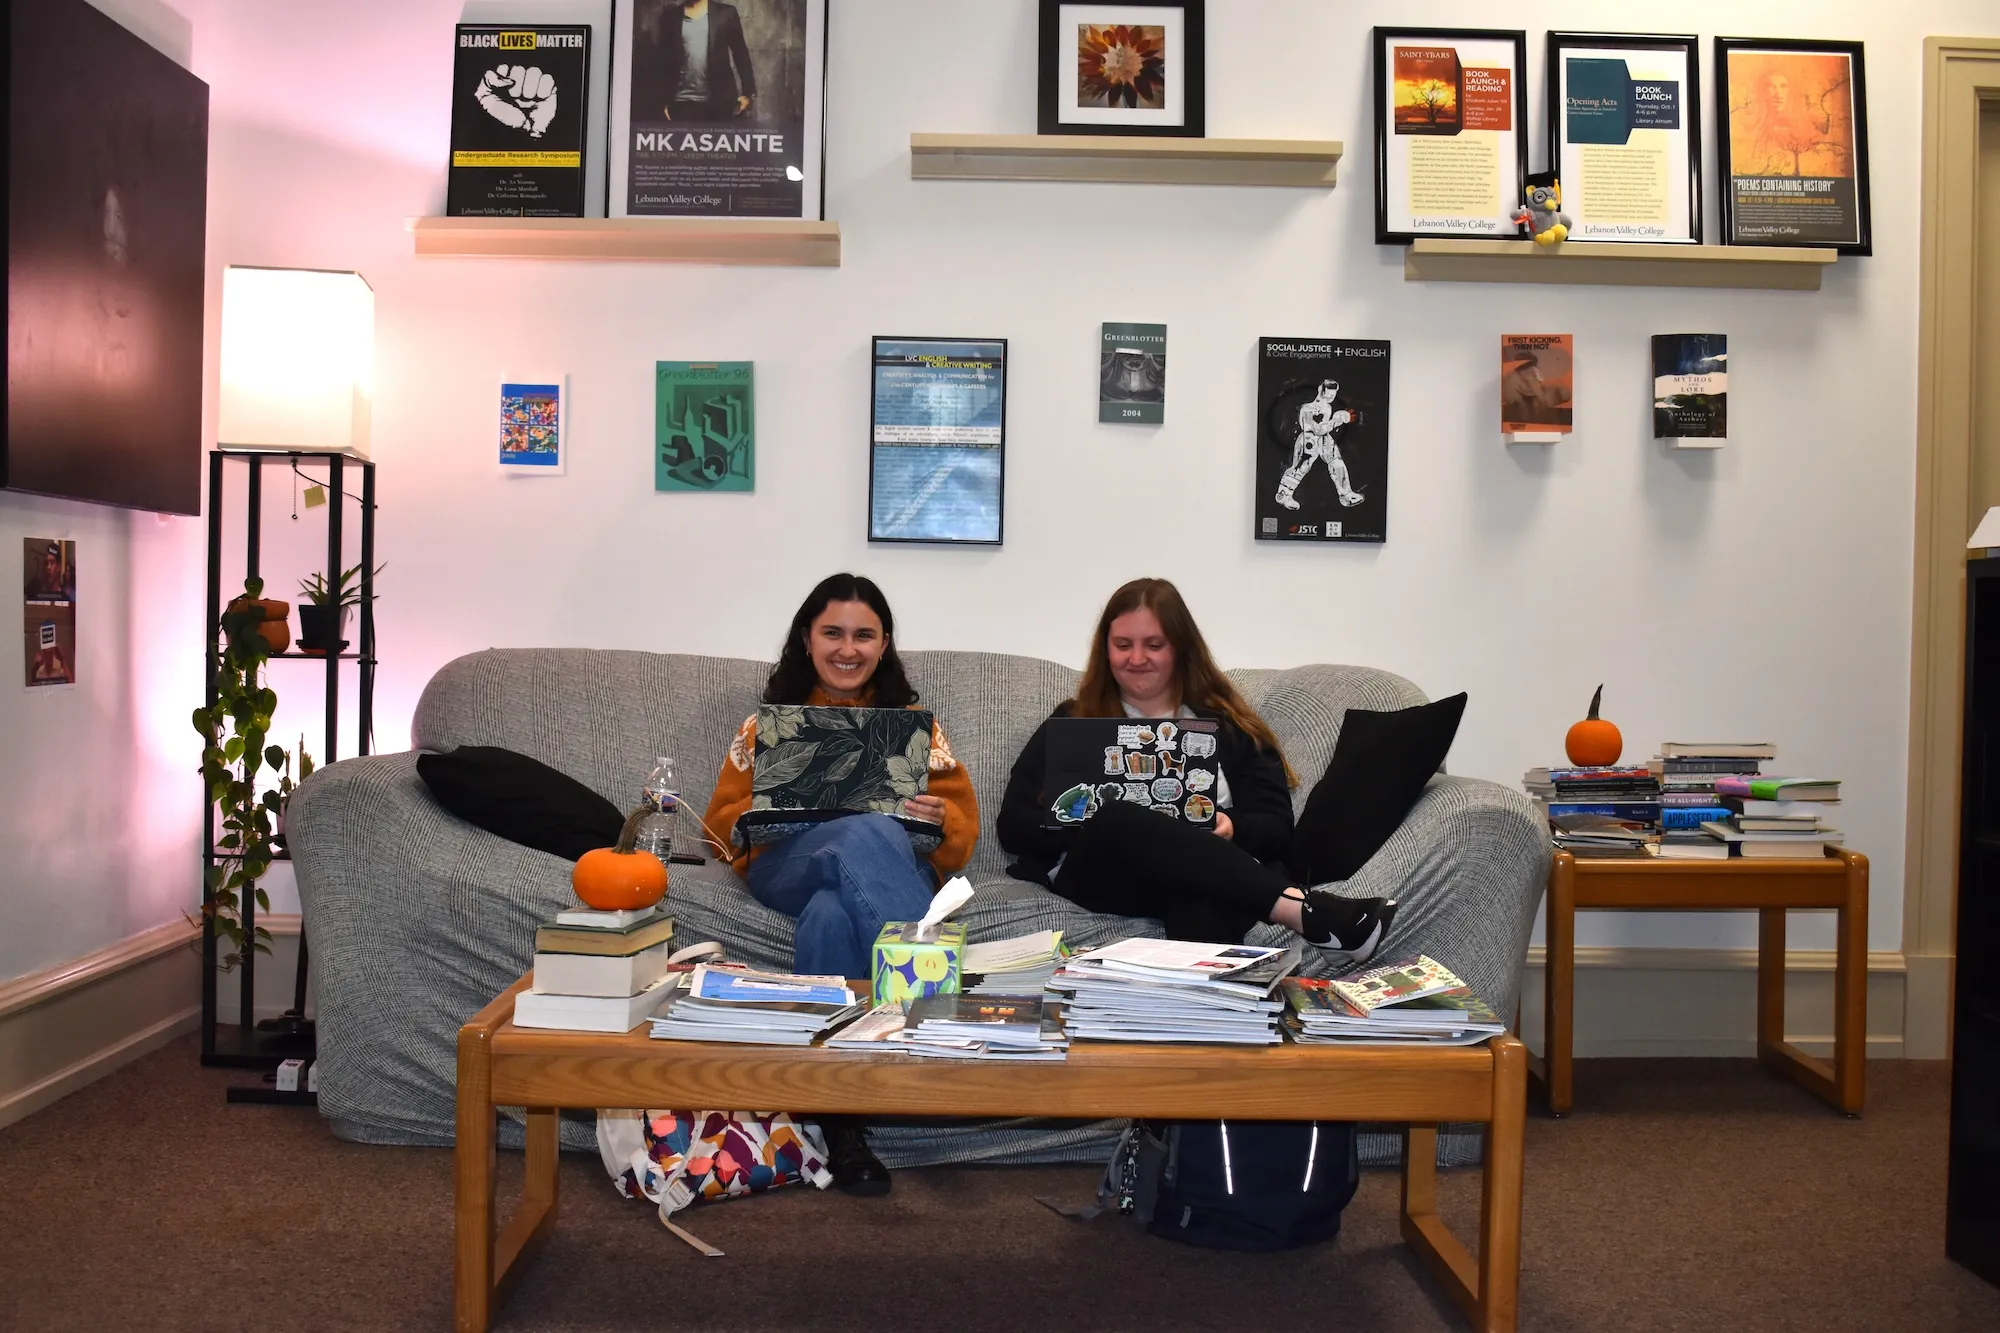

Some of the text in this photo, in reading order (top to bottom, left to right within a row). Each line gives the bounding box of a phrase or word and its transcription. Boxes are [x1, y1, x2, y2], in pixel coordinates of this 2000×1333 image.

[460, 35, 583, 47] BLACK LIVES MATTER
[1399, 51, 1450, 59] SAINT-YBARS
[1567, 97, 1617, 107] Opening Acts
[1635, 93, 1672, 101] LAUNCH
[636, 133, 784, 153] MK ASANTE
[1761, 179, 1801, 191] CONTAINING
[635, 194, 668, 204] Lebanon
[669, 194, 692, 205] Valley
[693, 195, 722, 207] College
[1413, 219, 1496, 230] Lebanon Valley College
[1762, 226, 1778, 234] Valley
[1585, 225, 1665, 236] Lebanon Valley College
[1267, 344, 1297, 352] SOCIAL
[1345, 348, 1386, 357] ENGLISH
[1290, 351, 1331, 360] Engagement
[658, 368, 731, 381] Greenblotter
[1298, 525, 1317, 534] JSTC
[1668, 813, 1712, 825] APPLESEED
